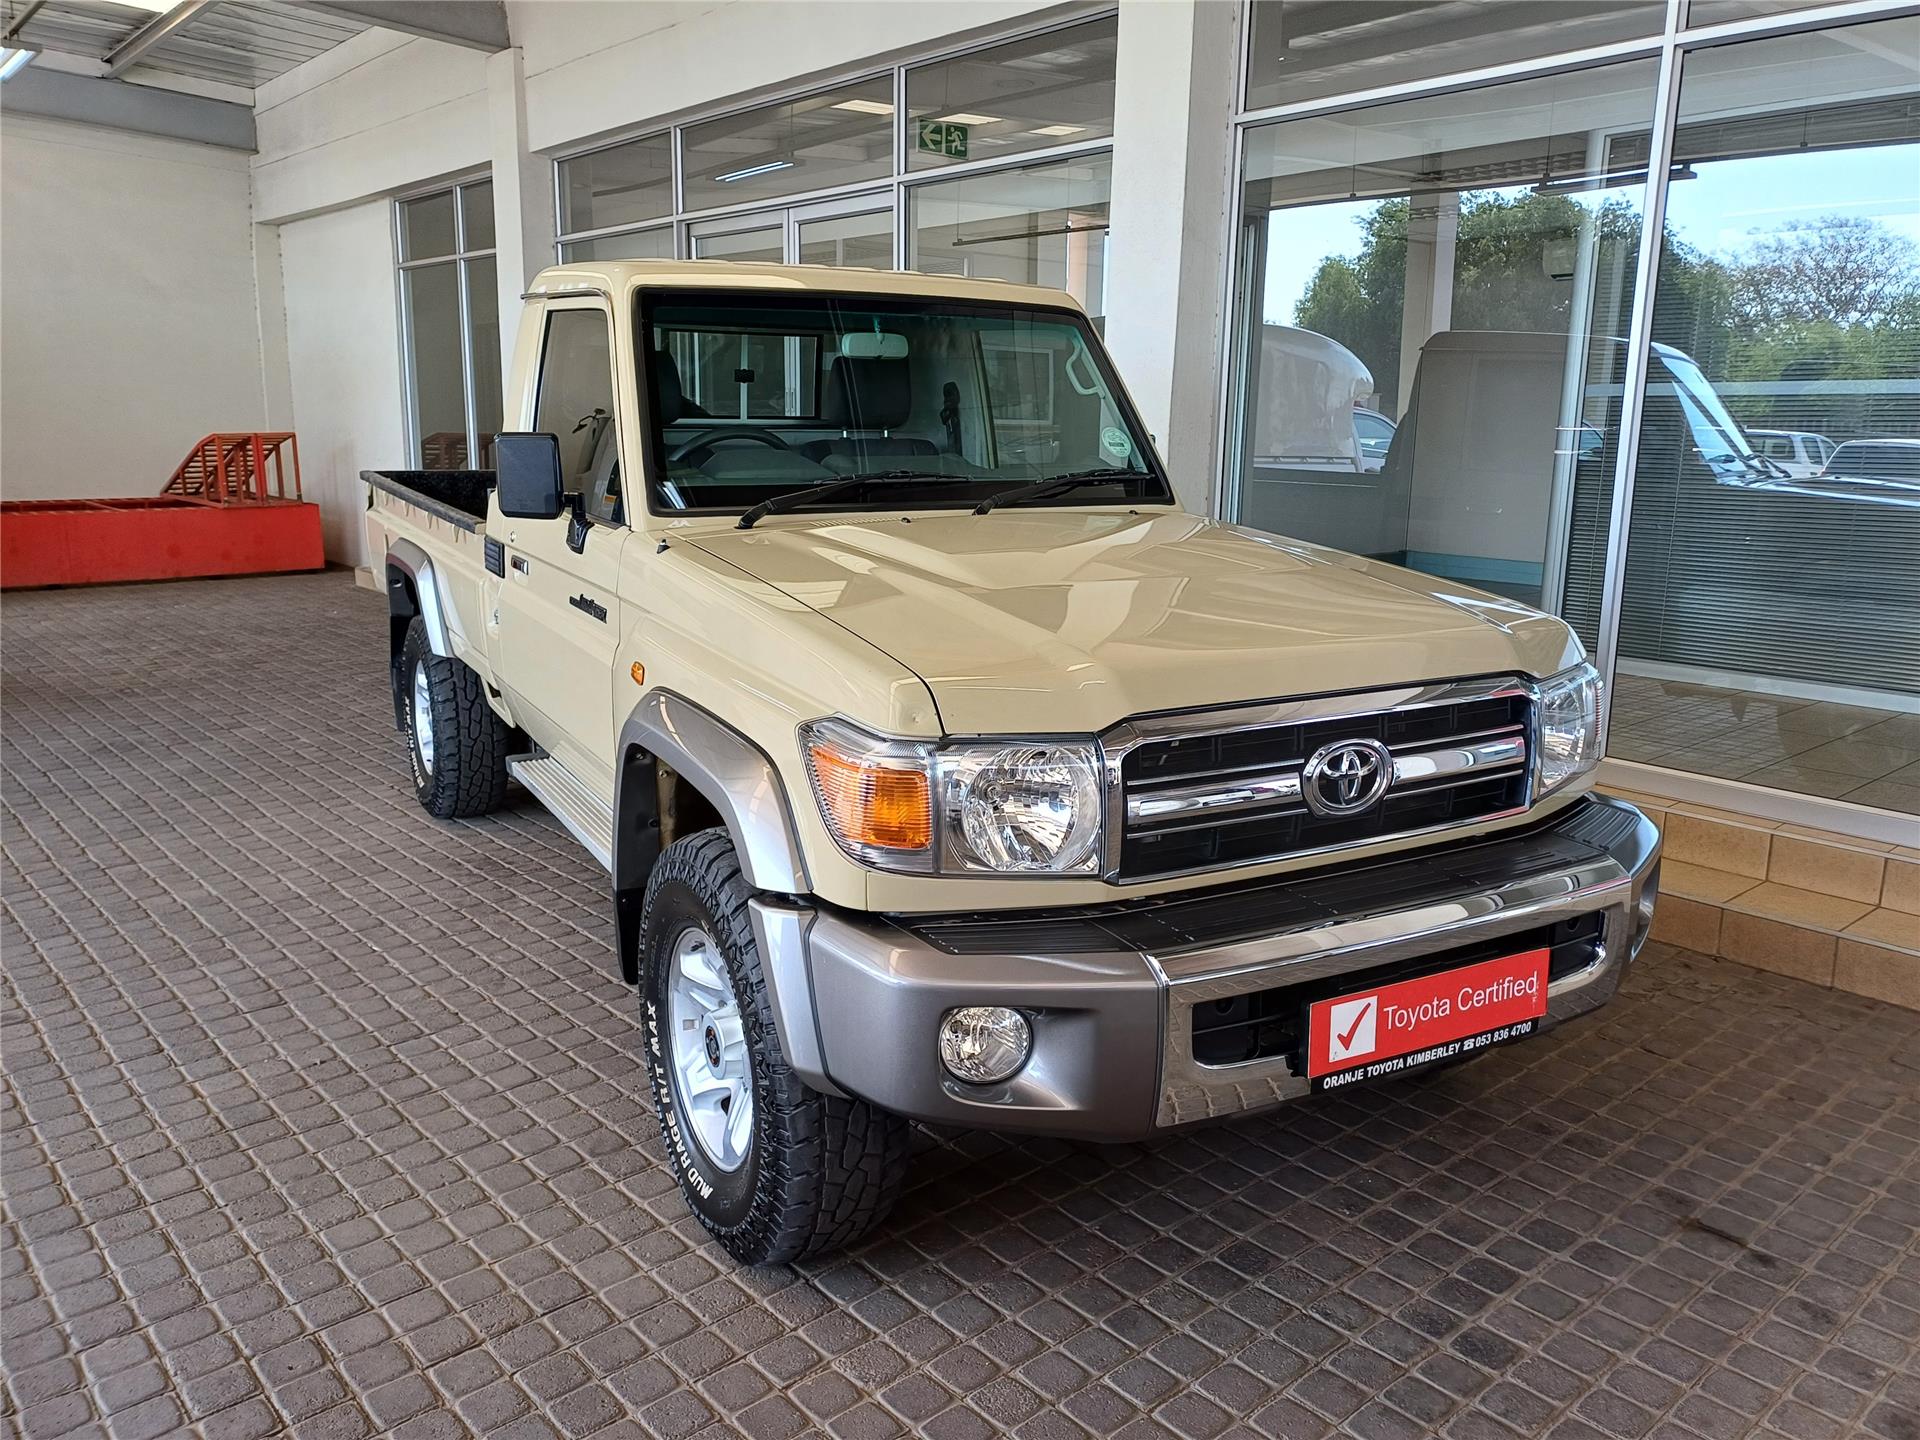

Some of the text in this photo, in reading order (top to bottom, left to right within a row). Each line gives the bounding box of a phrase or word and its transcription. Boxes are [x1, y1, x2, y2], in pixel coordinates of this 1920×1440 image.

[1384, 971, 1538, 1030] Toyota Certified
[1323, 1021, 1532, 1089] ORANJE TOYOTA KIMBERLEY 053 836 4700
[647, 1001, 714, 1199] MUD RAGE R/T MAX
